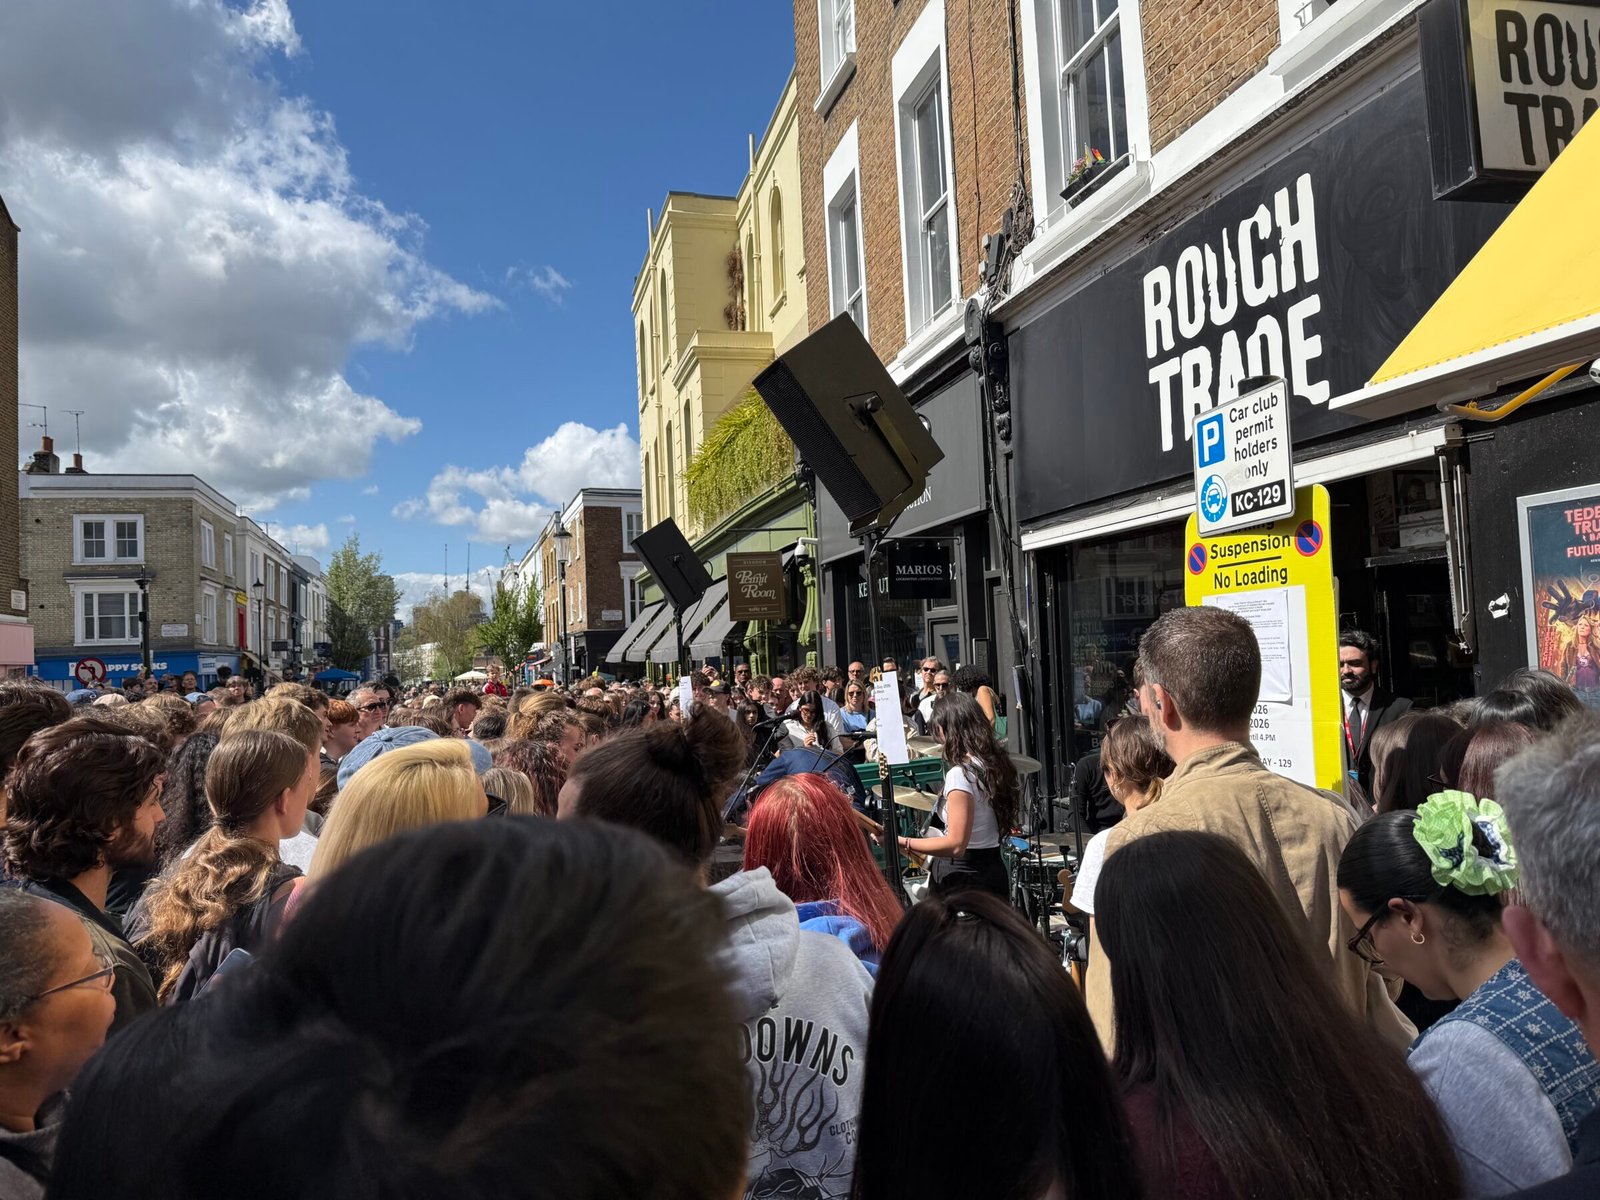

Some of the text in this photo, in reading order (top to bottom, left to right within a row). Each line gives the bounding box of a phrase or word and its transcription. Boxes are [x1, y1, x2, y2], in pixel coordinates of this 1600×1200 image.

[1495, 9, 1600, 91] ROU
[1143, 173, 1320, 359] ROUGH
[1229, 392, 1279, 423] Car club
[1203, 420, 1220, 463] P
[1235, 414, 1274, 445] permit
[1234, 437, 1278, 462] holders
[1245, 459, 1269, 479] only
[1235, 484, 1281, 513] KC-129
[1210, 534, 1291, 560] Suspension
[735, 570, 768, 587] Permit
[896, 565, 943, 575] MARIOS
[1214, 565, 1288, 589] No Loading
[741, 584, 777, 600] Room
[105, 662, 168, 672] PPY SOKS
[1253, 704, 1268, 715] 026
[1262, 757, 1272, 766] AY
[1278, 758, 1292, 768] 129
